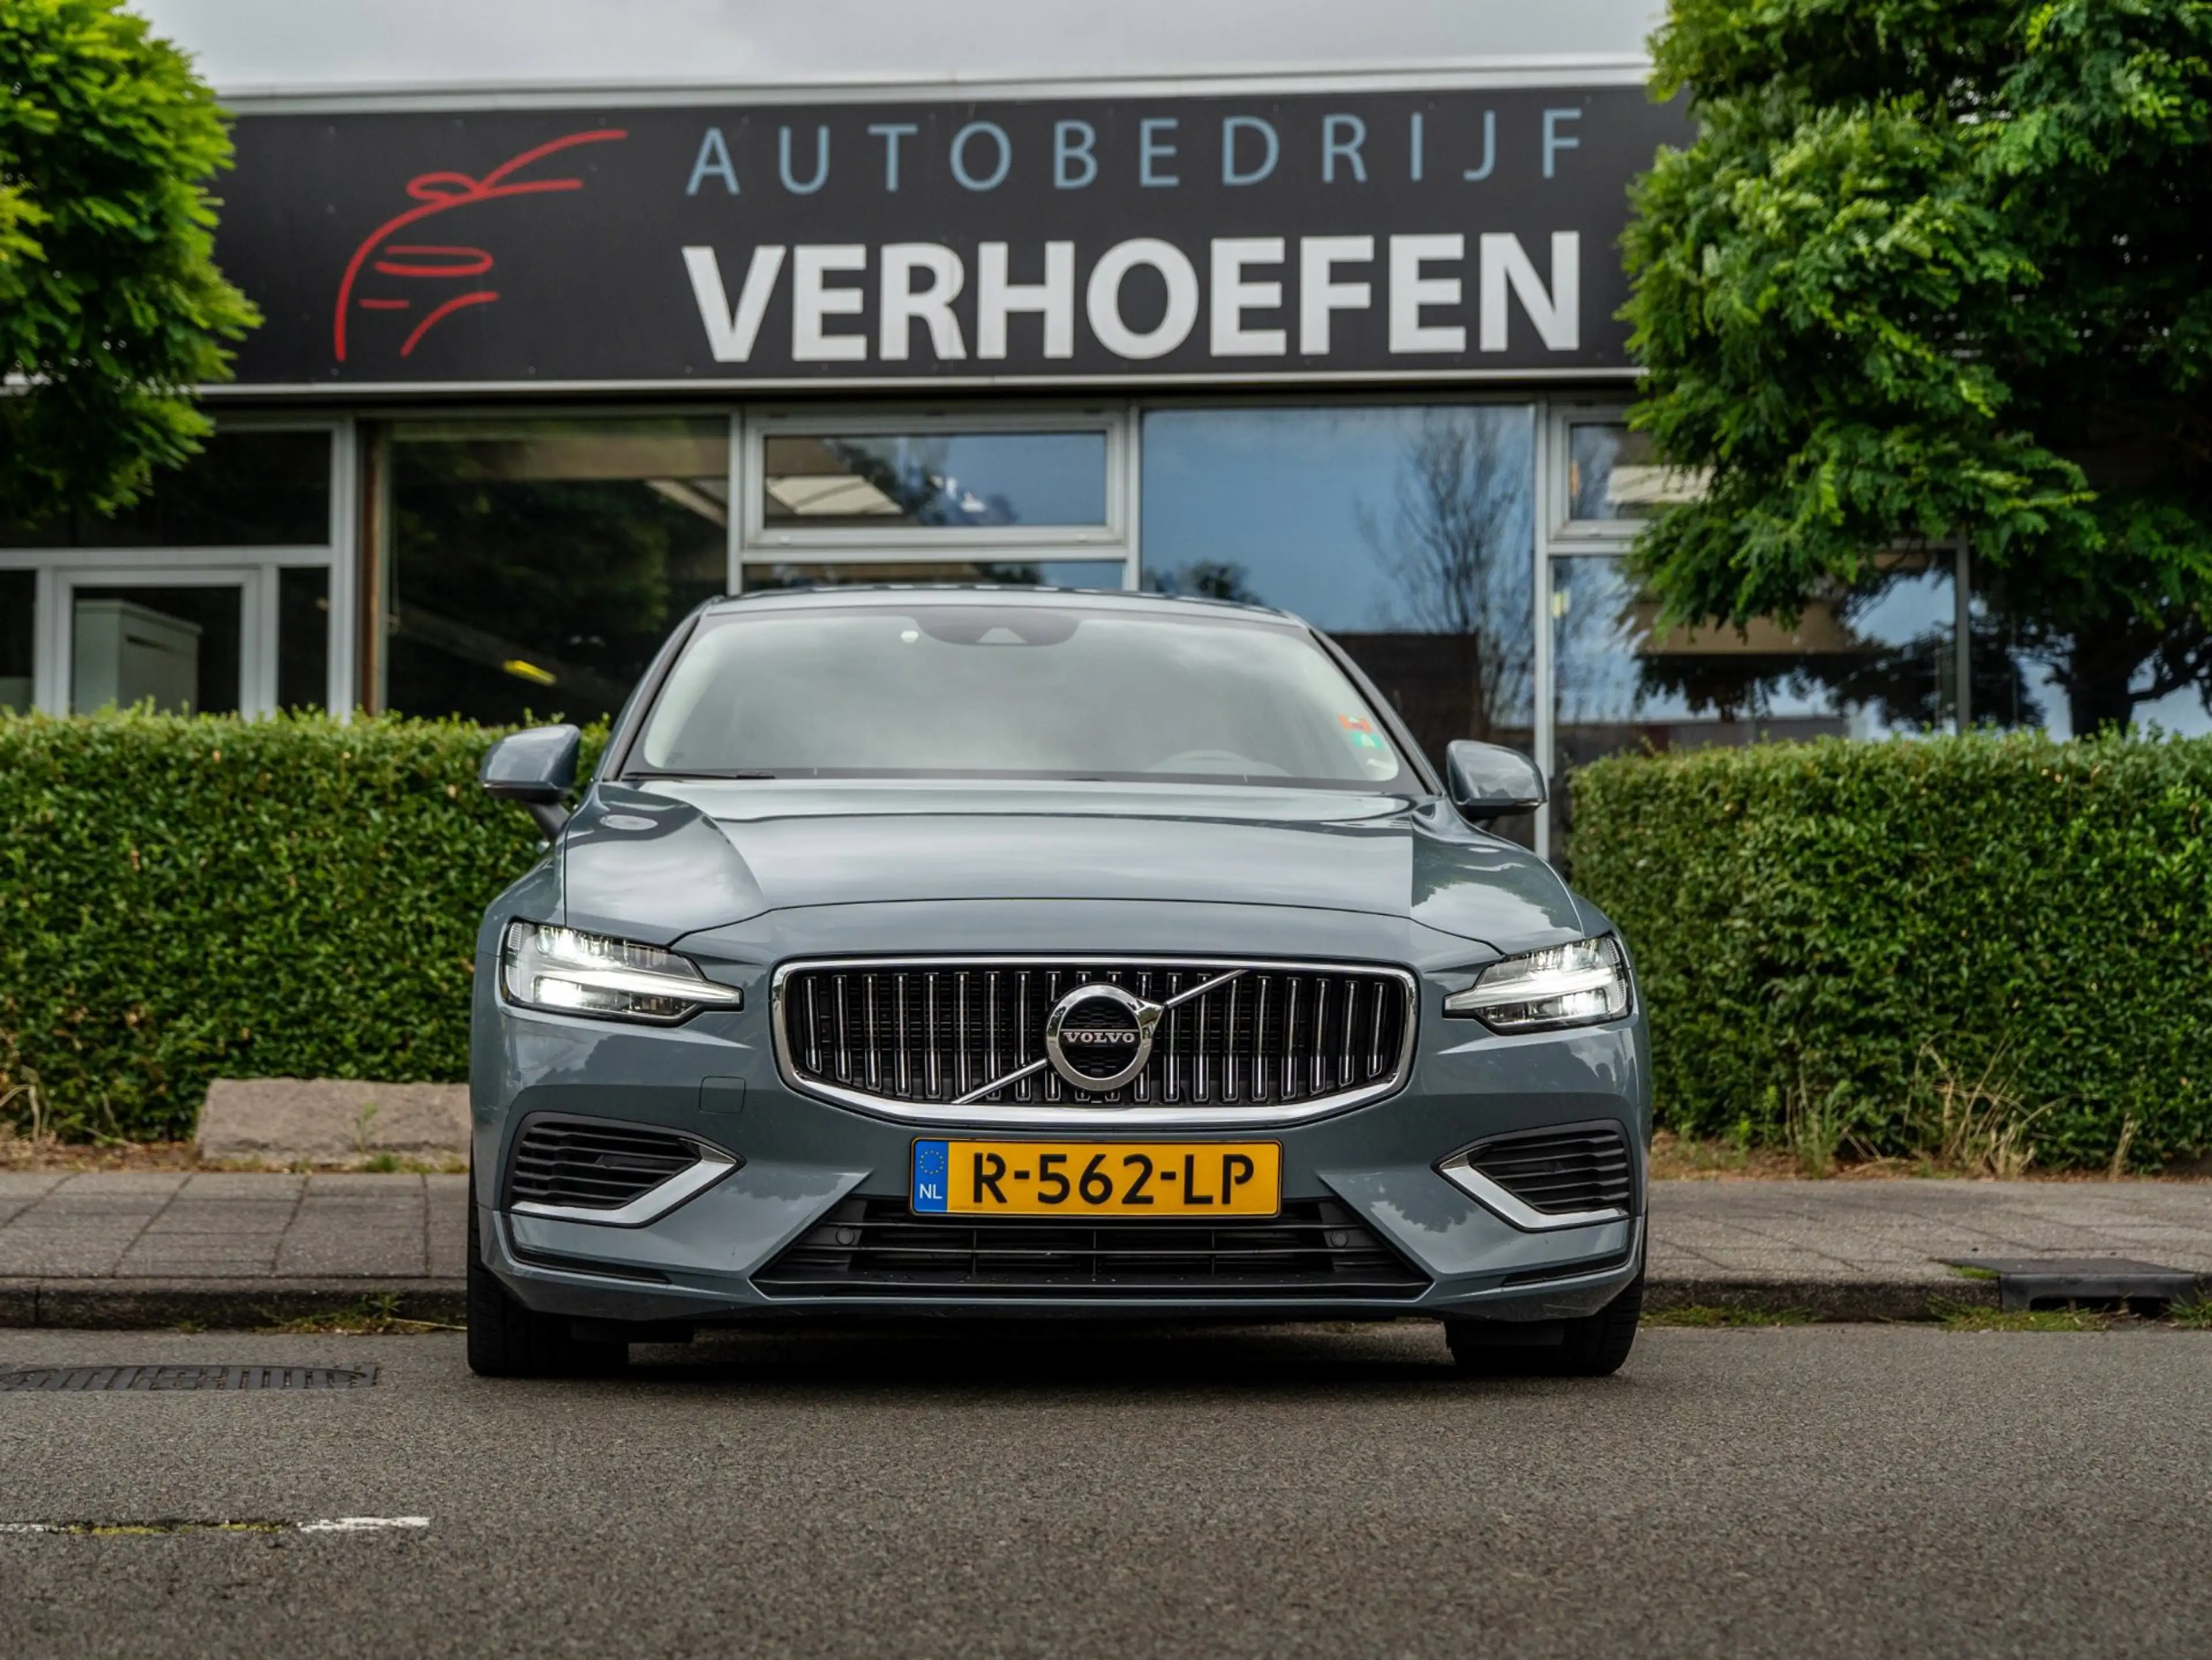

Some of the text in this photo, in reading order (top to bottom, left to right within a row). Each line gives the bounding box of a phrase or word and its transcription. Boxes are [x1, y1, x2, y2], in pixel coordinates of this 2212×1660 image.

[686, 107, 1583, 195] AUTOBEDRIJF
[681, 231, 1580, 363] VERHOEFEN
[1063, 1032, 1135, 1043] VOLVO
[920, 1183, 942, 1199] NL
[972, 1152, 1255, 1205] R-562-LP
